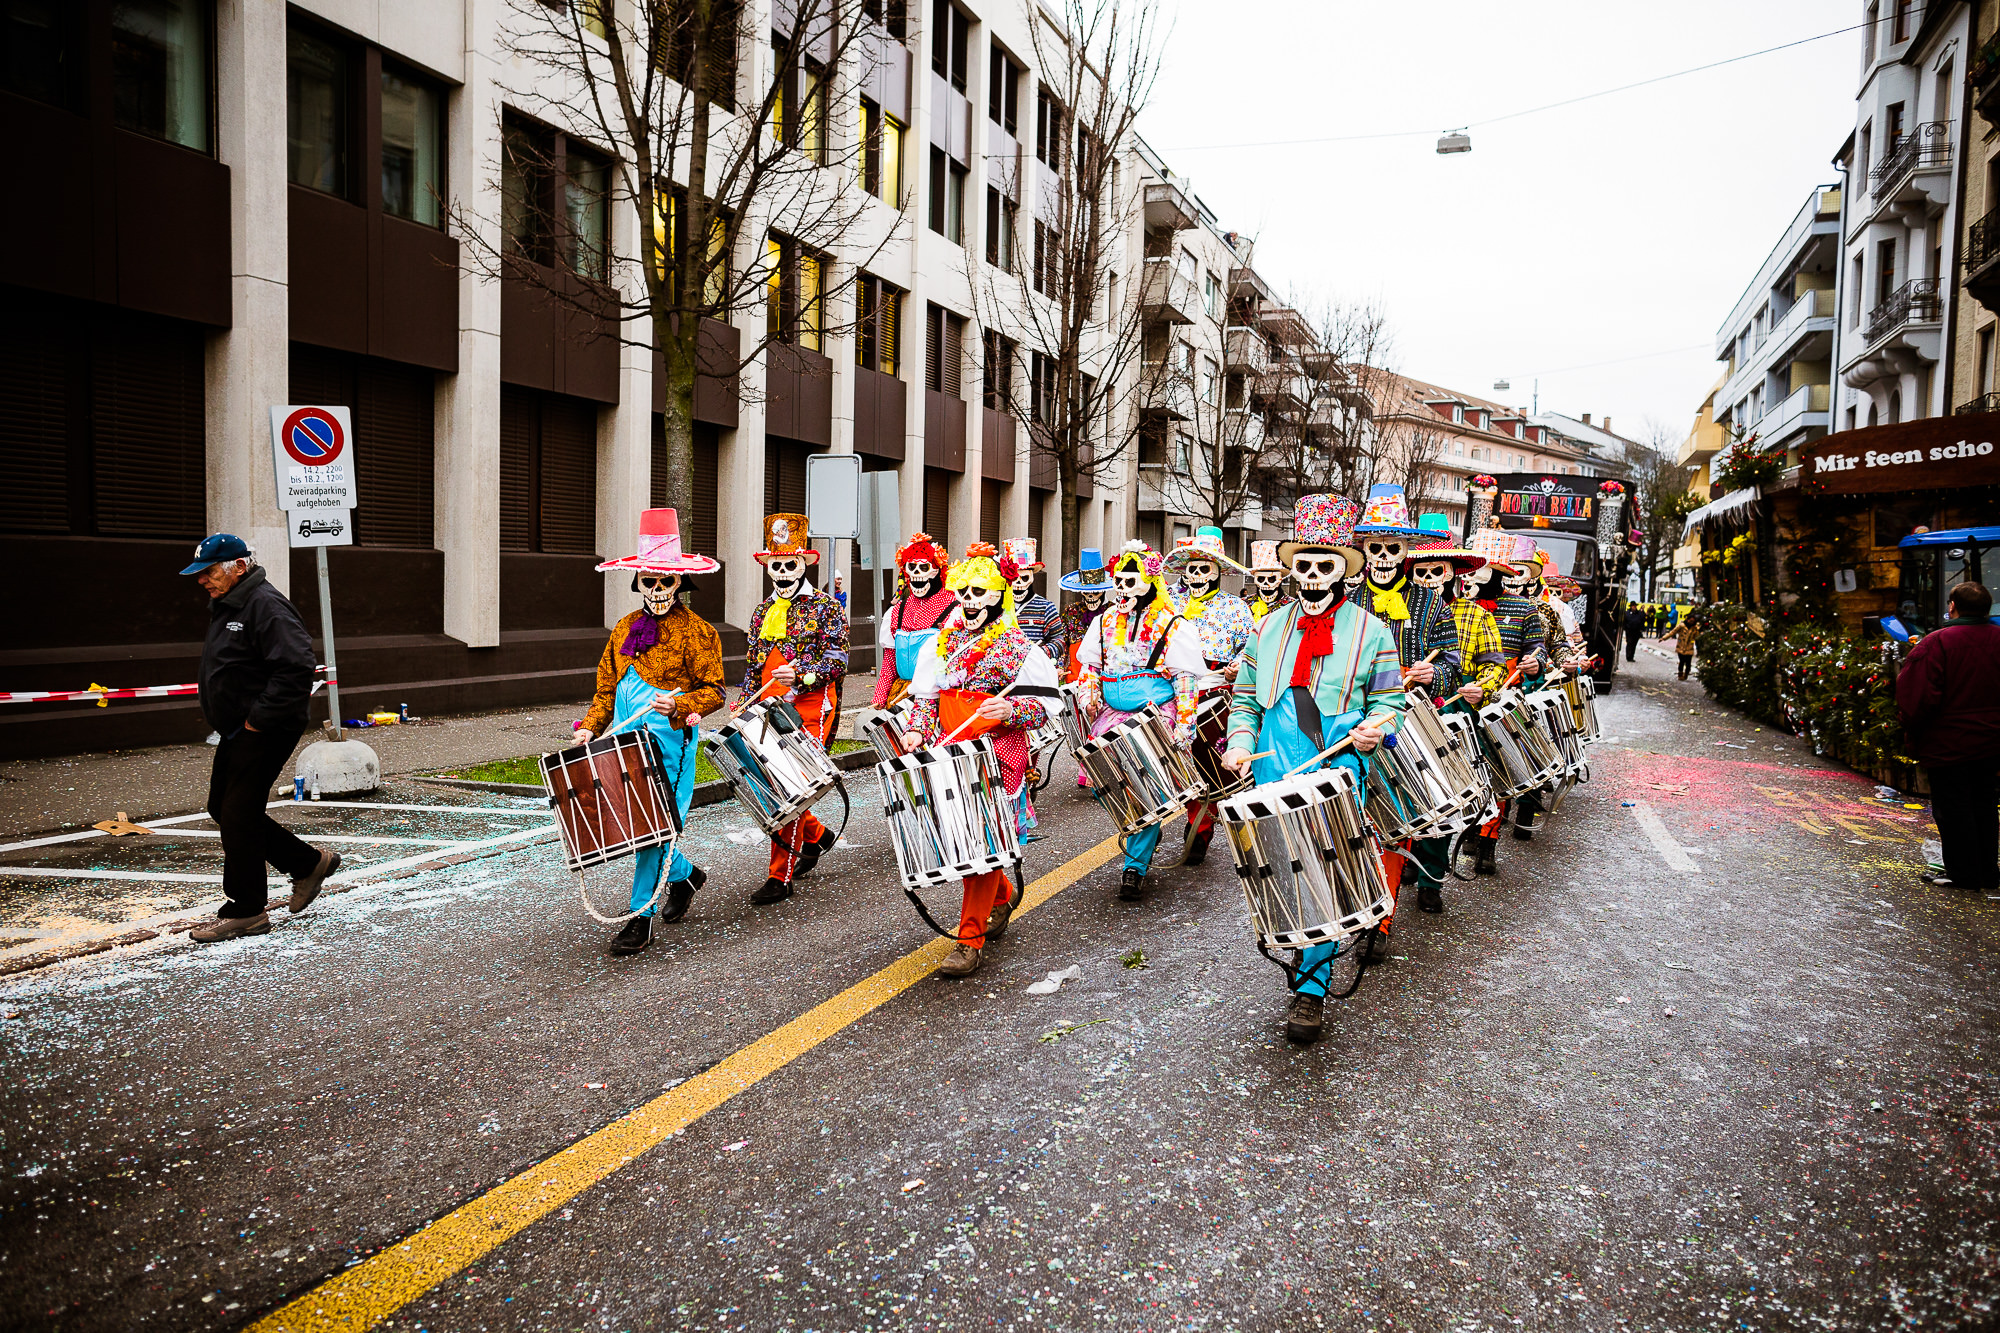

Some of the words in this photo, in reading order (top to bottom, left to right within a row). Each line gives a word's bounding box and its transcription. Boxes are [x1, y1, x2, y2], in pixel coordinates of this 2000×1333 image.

[1814, 454, 1859, 473] Mir
[1865, 450, 1923, 468] feen
[1929, 440, 1994, 461] scho
[288, 486, 347, 497] Zweiradparking
[296, 498, 341, 509] aufgehoben
[1500, 493, 1546, 514] MORTA
[1550, 496, 1592, 517] BELLA
